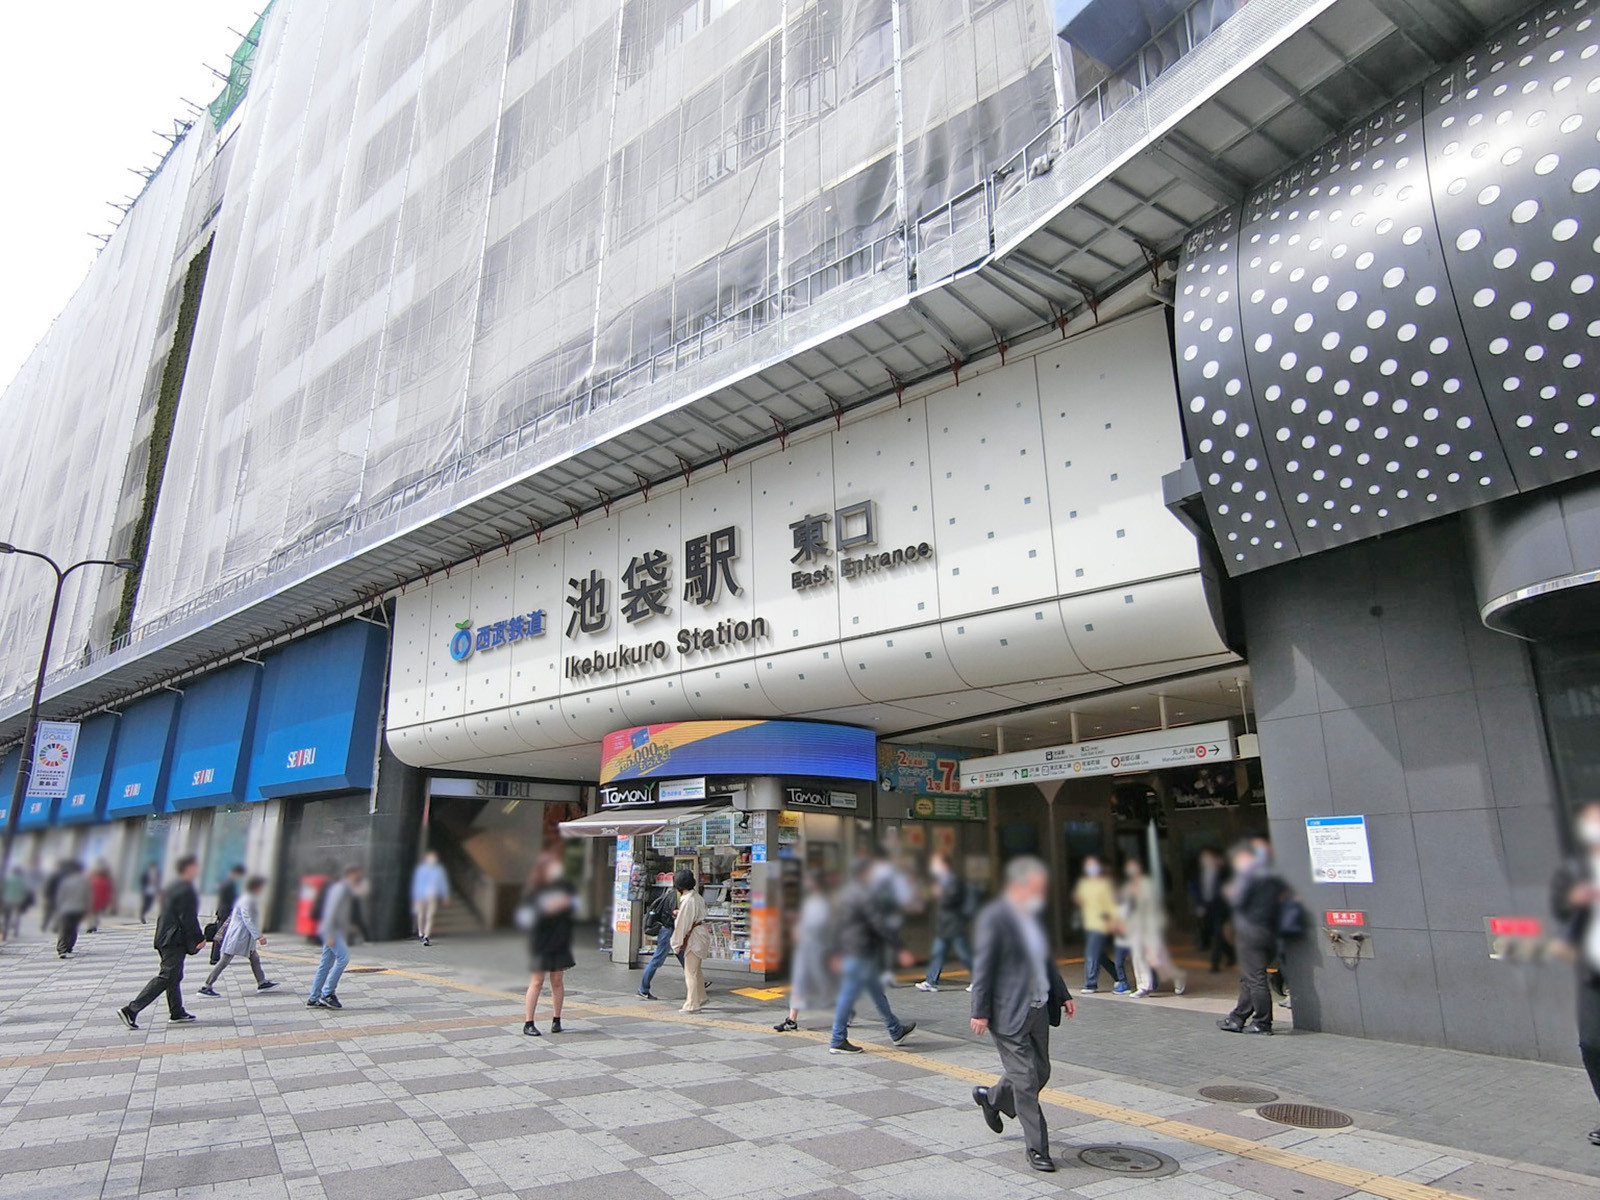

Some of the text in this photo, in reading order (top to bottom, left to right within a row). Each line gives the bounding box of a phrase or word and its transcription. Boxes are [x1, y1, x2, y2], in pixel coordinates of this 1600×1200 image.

[789, 500, 877, 564] 東口
[565, 525, 743, 640] 池袋駅
[792, 542, 933, 589] East Entrance
[476, 609, 547, 651] 西武鉄道
[565, 617, 768, 678] Ikebukuro Station
[192, 768, 215, 785] SEIBU
[287, 748, 316, 768] SEIBU
[475, 781, 530, 797] SEIBU
